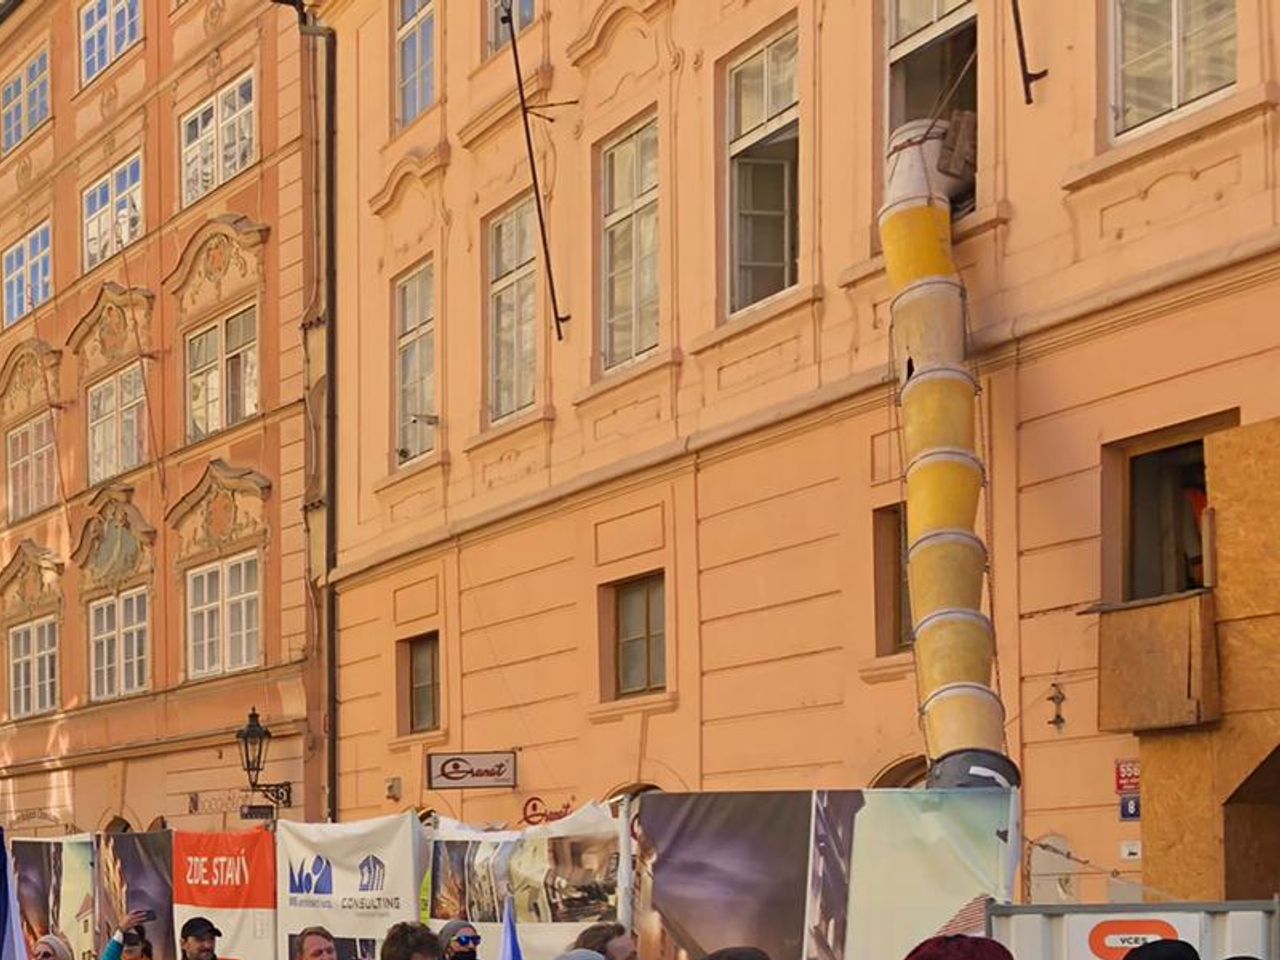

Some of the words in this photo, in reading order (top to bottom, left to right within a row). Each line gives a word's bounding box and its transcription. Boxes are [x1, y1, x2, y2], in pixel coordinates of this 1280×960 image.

[186, 856, 210, 885] ZDE
[212, 849, 250, 885] STAVÍ
[341, 897, 400, 909] CONSULTING
